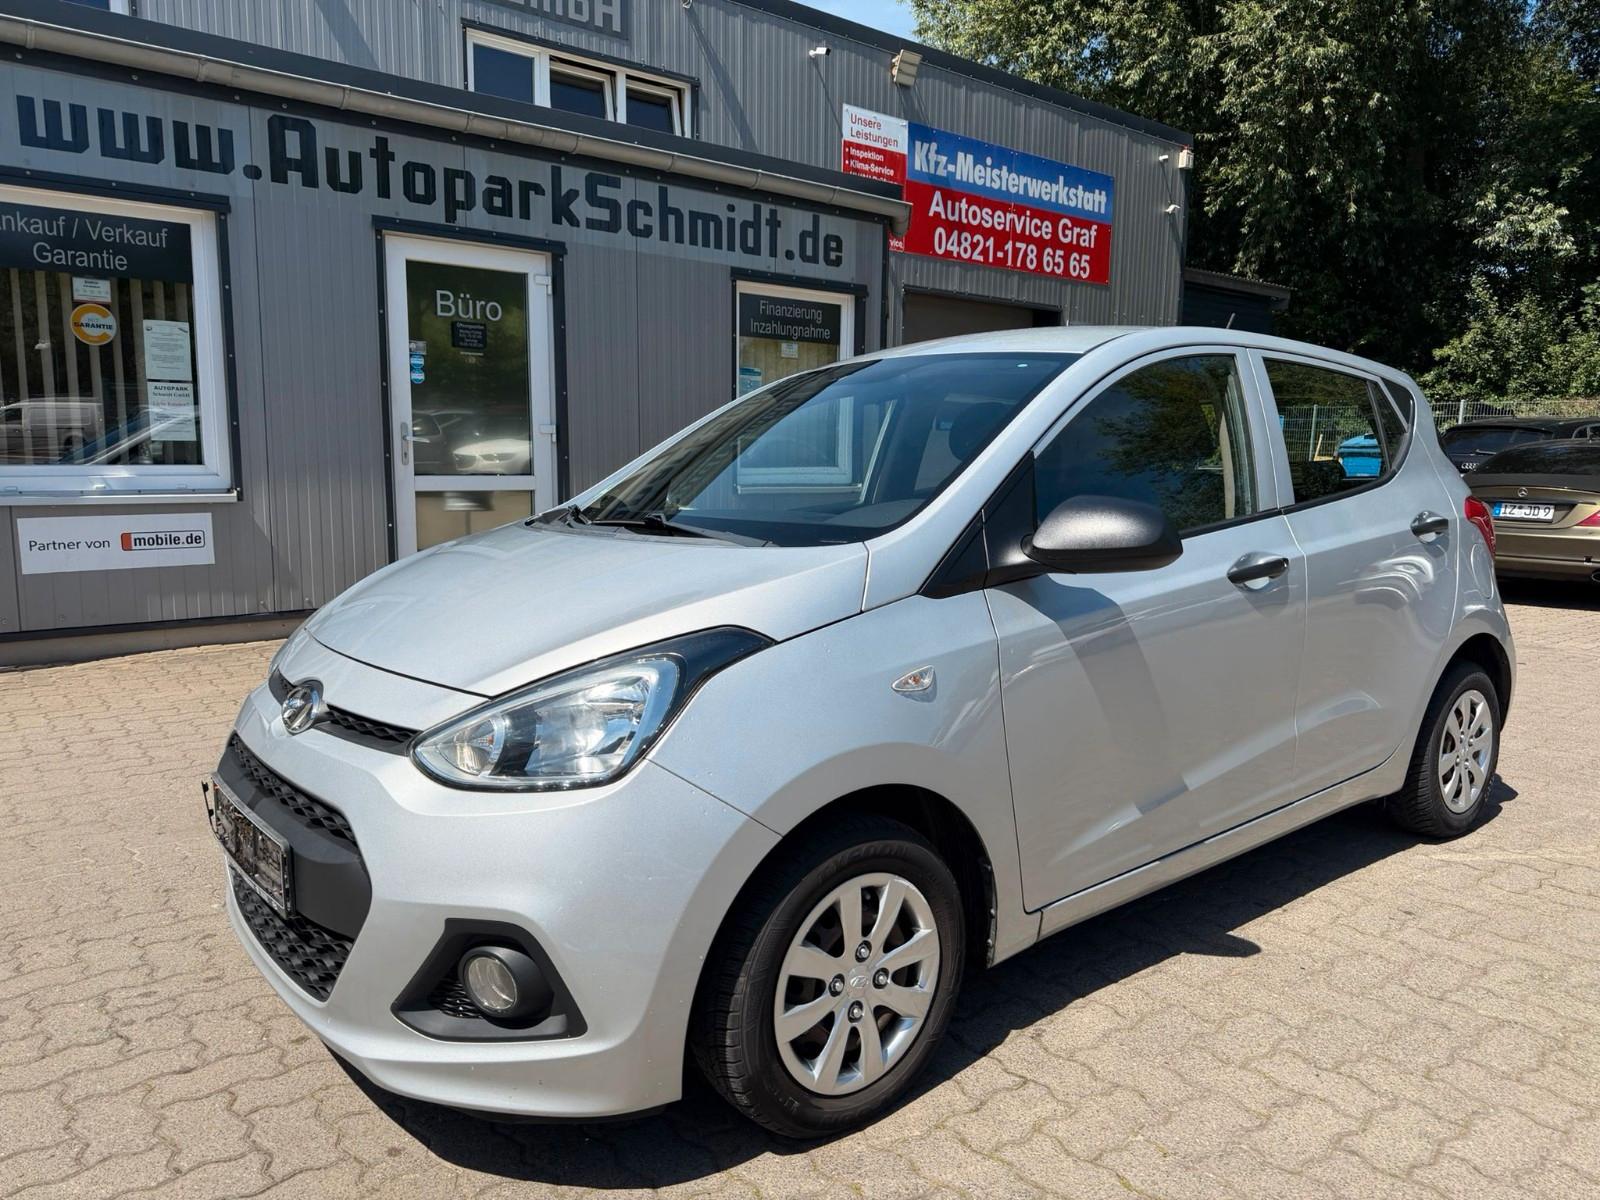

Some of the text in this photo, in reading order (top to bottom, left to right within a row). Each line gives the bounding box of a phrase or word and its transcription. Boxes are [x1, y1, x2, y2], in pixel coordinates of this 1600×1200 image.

[850, 113, 882, 130] Unsere
[850, 127, 899, 147] Leistungen
[850, 147, 884, 162] Inspektion
[850, 160, 895, 176] Klima-Service
[914, 141, 1107, 214] Kfz-Meisterwerkstatt
[16, 95, 843, 267] www.AutoparkSchmidt.de
[0, 211, 65, 237] nkauf
[86, 219, 168, 249] Verkauf
[929, 191, 1097, 249] Autoservice Graf
[33, 242, 128, 271] Garantie
[934, 227, 1091, 279] 04821-178 65 65
[436, 289, 502, 322] Büro
[759, 300, 823, 323] Finanzierung
[750, 318, 831, 340] Inzahlungnahme
[1502, 505, 1551, 517] IZ JD 9
[29, 533, 202, 552] Partner von mobile.de
